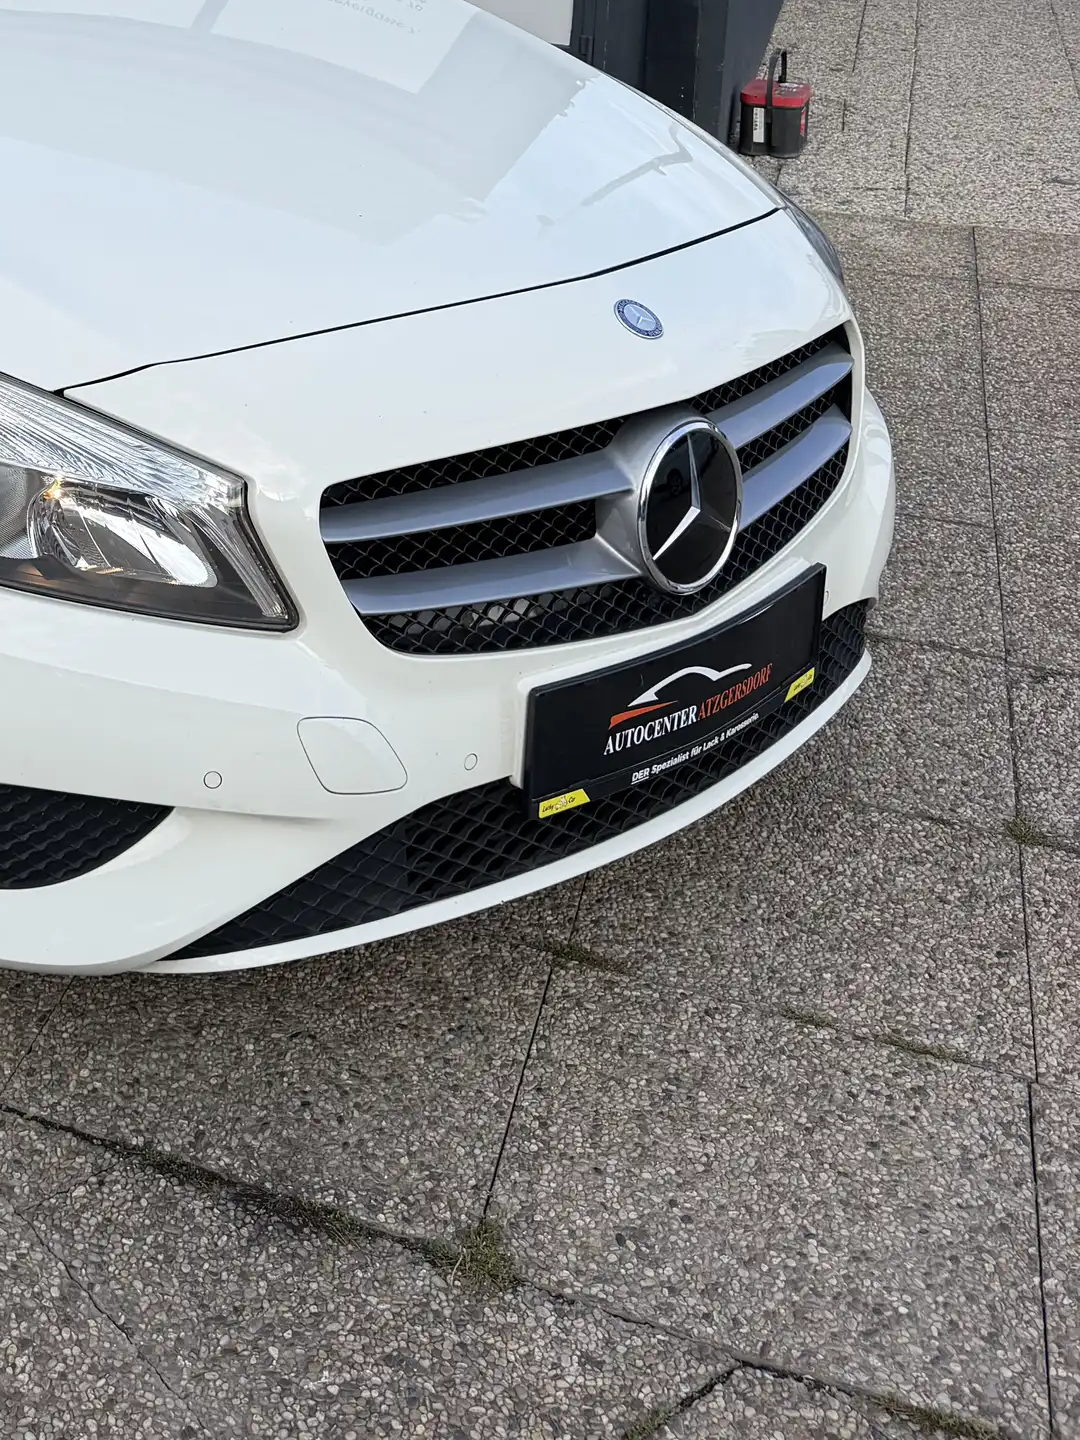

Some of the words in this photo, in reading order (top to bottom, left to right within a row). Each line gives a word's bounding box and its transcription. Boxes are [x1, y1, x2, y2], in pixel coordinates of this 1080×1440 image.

[603, 705, 697, 755] AUTOCENTER
[697, 663, 772, 720] ATZGERSDORF
[631, 768, 649, 783] DER
[651, 751, 689, 774] Spezialist
[690, 746, 702, 758] für
